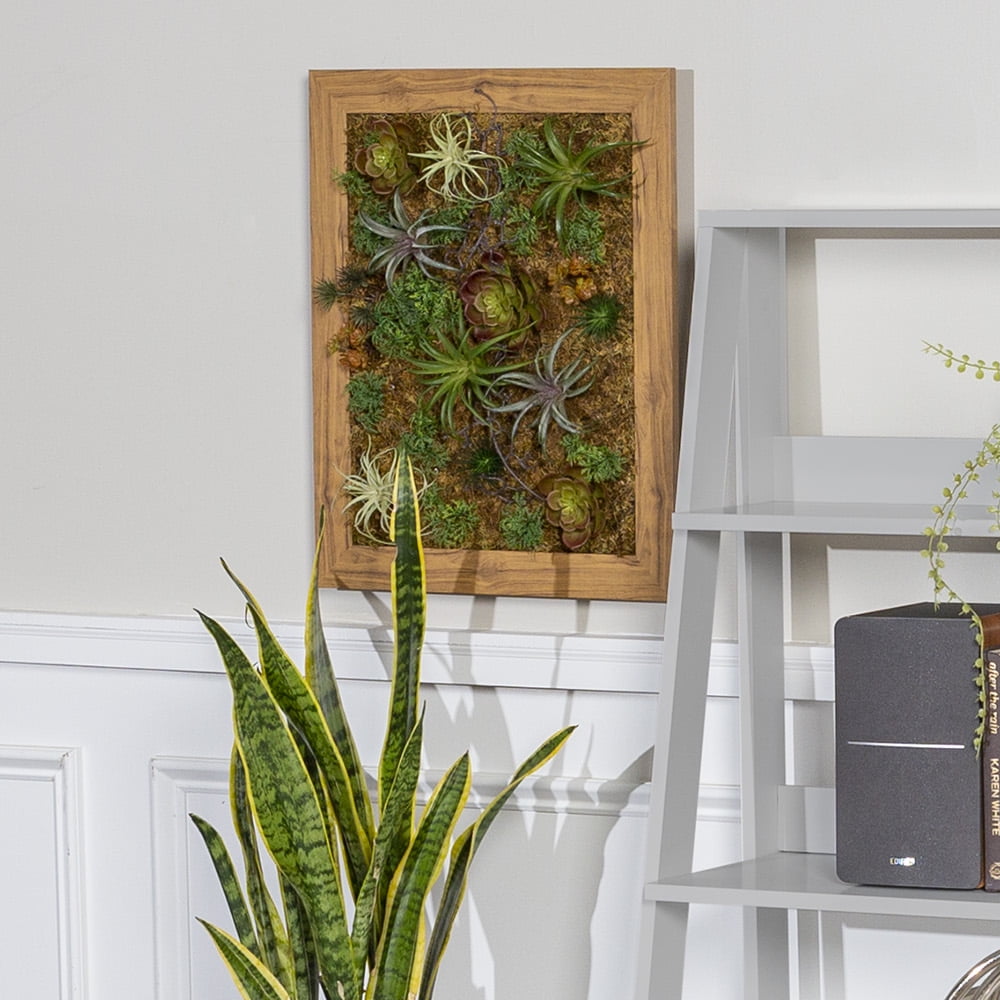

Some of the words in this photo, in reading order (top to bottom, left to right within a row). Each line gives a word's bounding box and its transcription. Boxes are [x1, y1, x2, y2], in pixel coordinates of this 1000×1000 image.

[987, 661, 999, 689] after
[989, 691, 999, 709] the
[989, 711, 999, 735] rain
[989, 758, 1000, 798] KAREN
[991, 799, 1000, 837] WHITE
